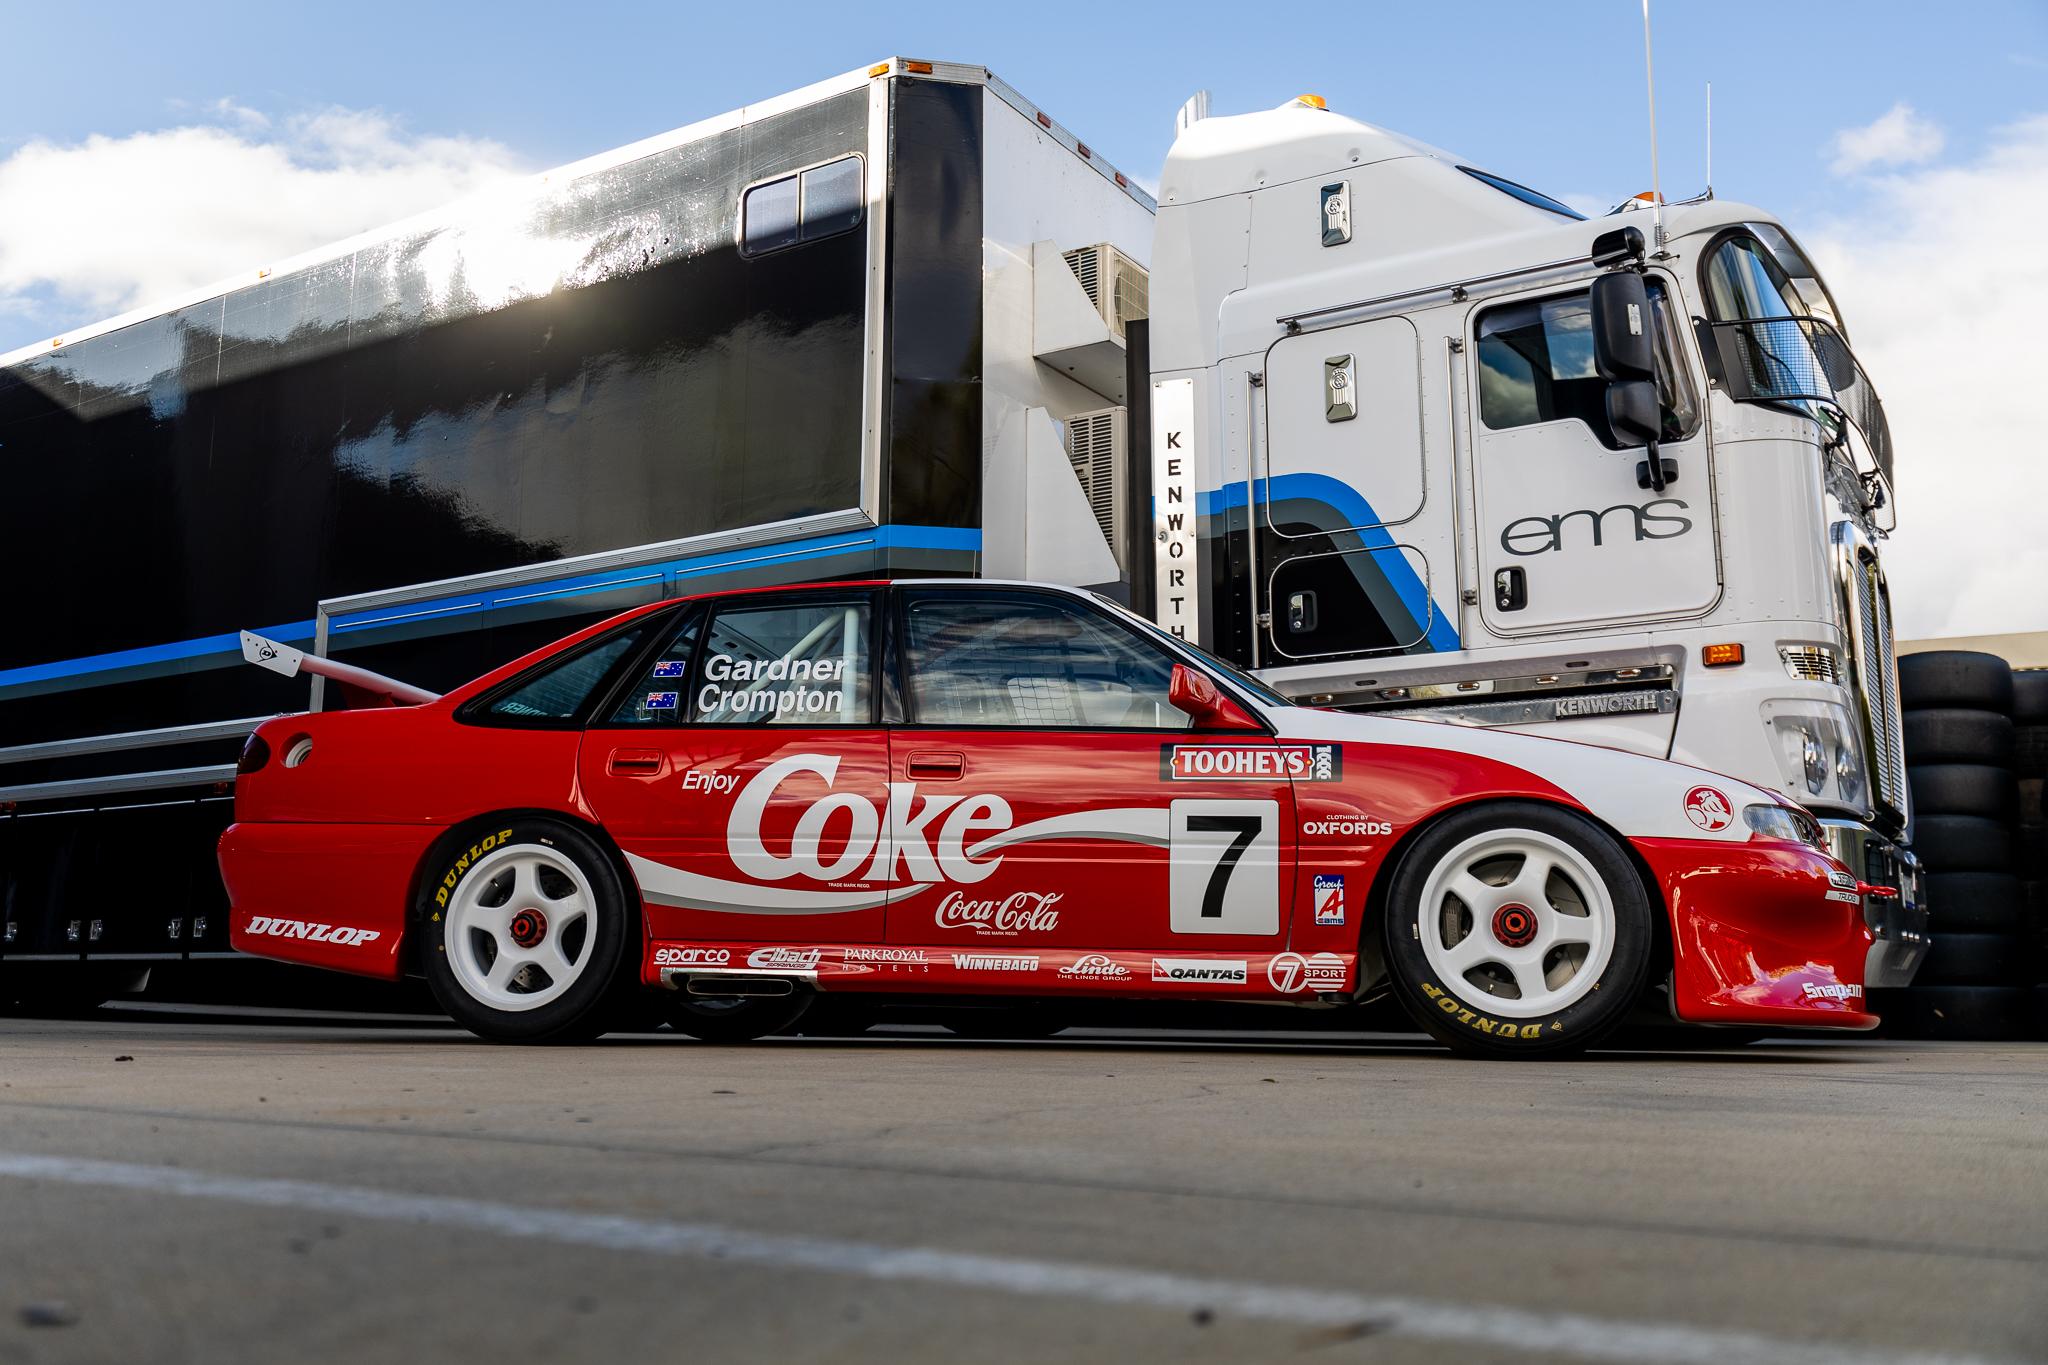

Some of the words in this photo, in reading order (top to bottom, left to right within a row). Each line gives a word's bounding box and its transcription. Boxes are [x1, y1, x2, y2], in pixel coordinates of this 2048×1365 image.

[1500, 498, 1693, 556] ems
[704, 654, 849, 682] Gardner
[698, 684, 844, 720] Crompton
[1555, 691, 1658, 717] KENWORTH
[1180, 750, 1304, 774] TOOHEYS
[682, 769, 740, 795] Enjoy
[727, 753, 1013, 884] Coke
[1303, 822, 1392, 836] OXFORDS
[435, 829, 513, 907] DUNLOP
[1187, 815, 1262, 918] 7
[1314, 875, 1344, 892] Group
[1318, 889, 1344, 917] A
[245, 915, 380, 946] DUNLOP
[655, 948, 730, 966] sparco
[747, 947, 821, 965] Eibach
[844, 948, 929, 962] PARKROYAL
[951, 954, 1040, 972] WINNEBAGO
[1059, 954, 1131, 975] Linde
[1170, 967, 1246, 981] QANTAS
[1304, 967, 1347, 978] SPORT
[1421, 982, 1544, 1039] DUNLOP
